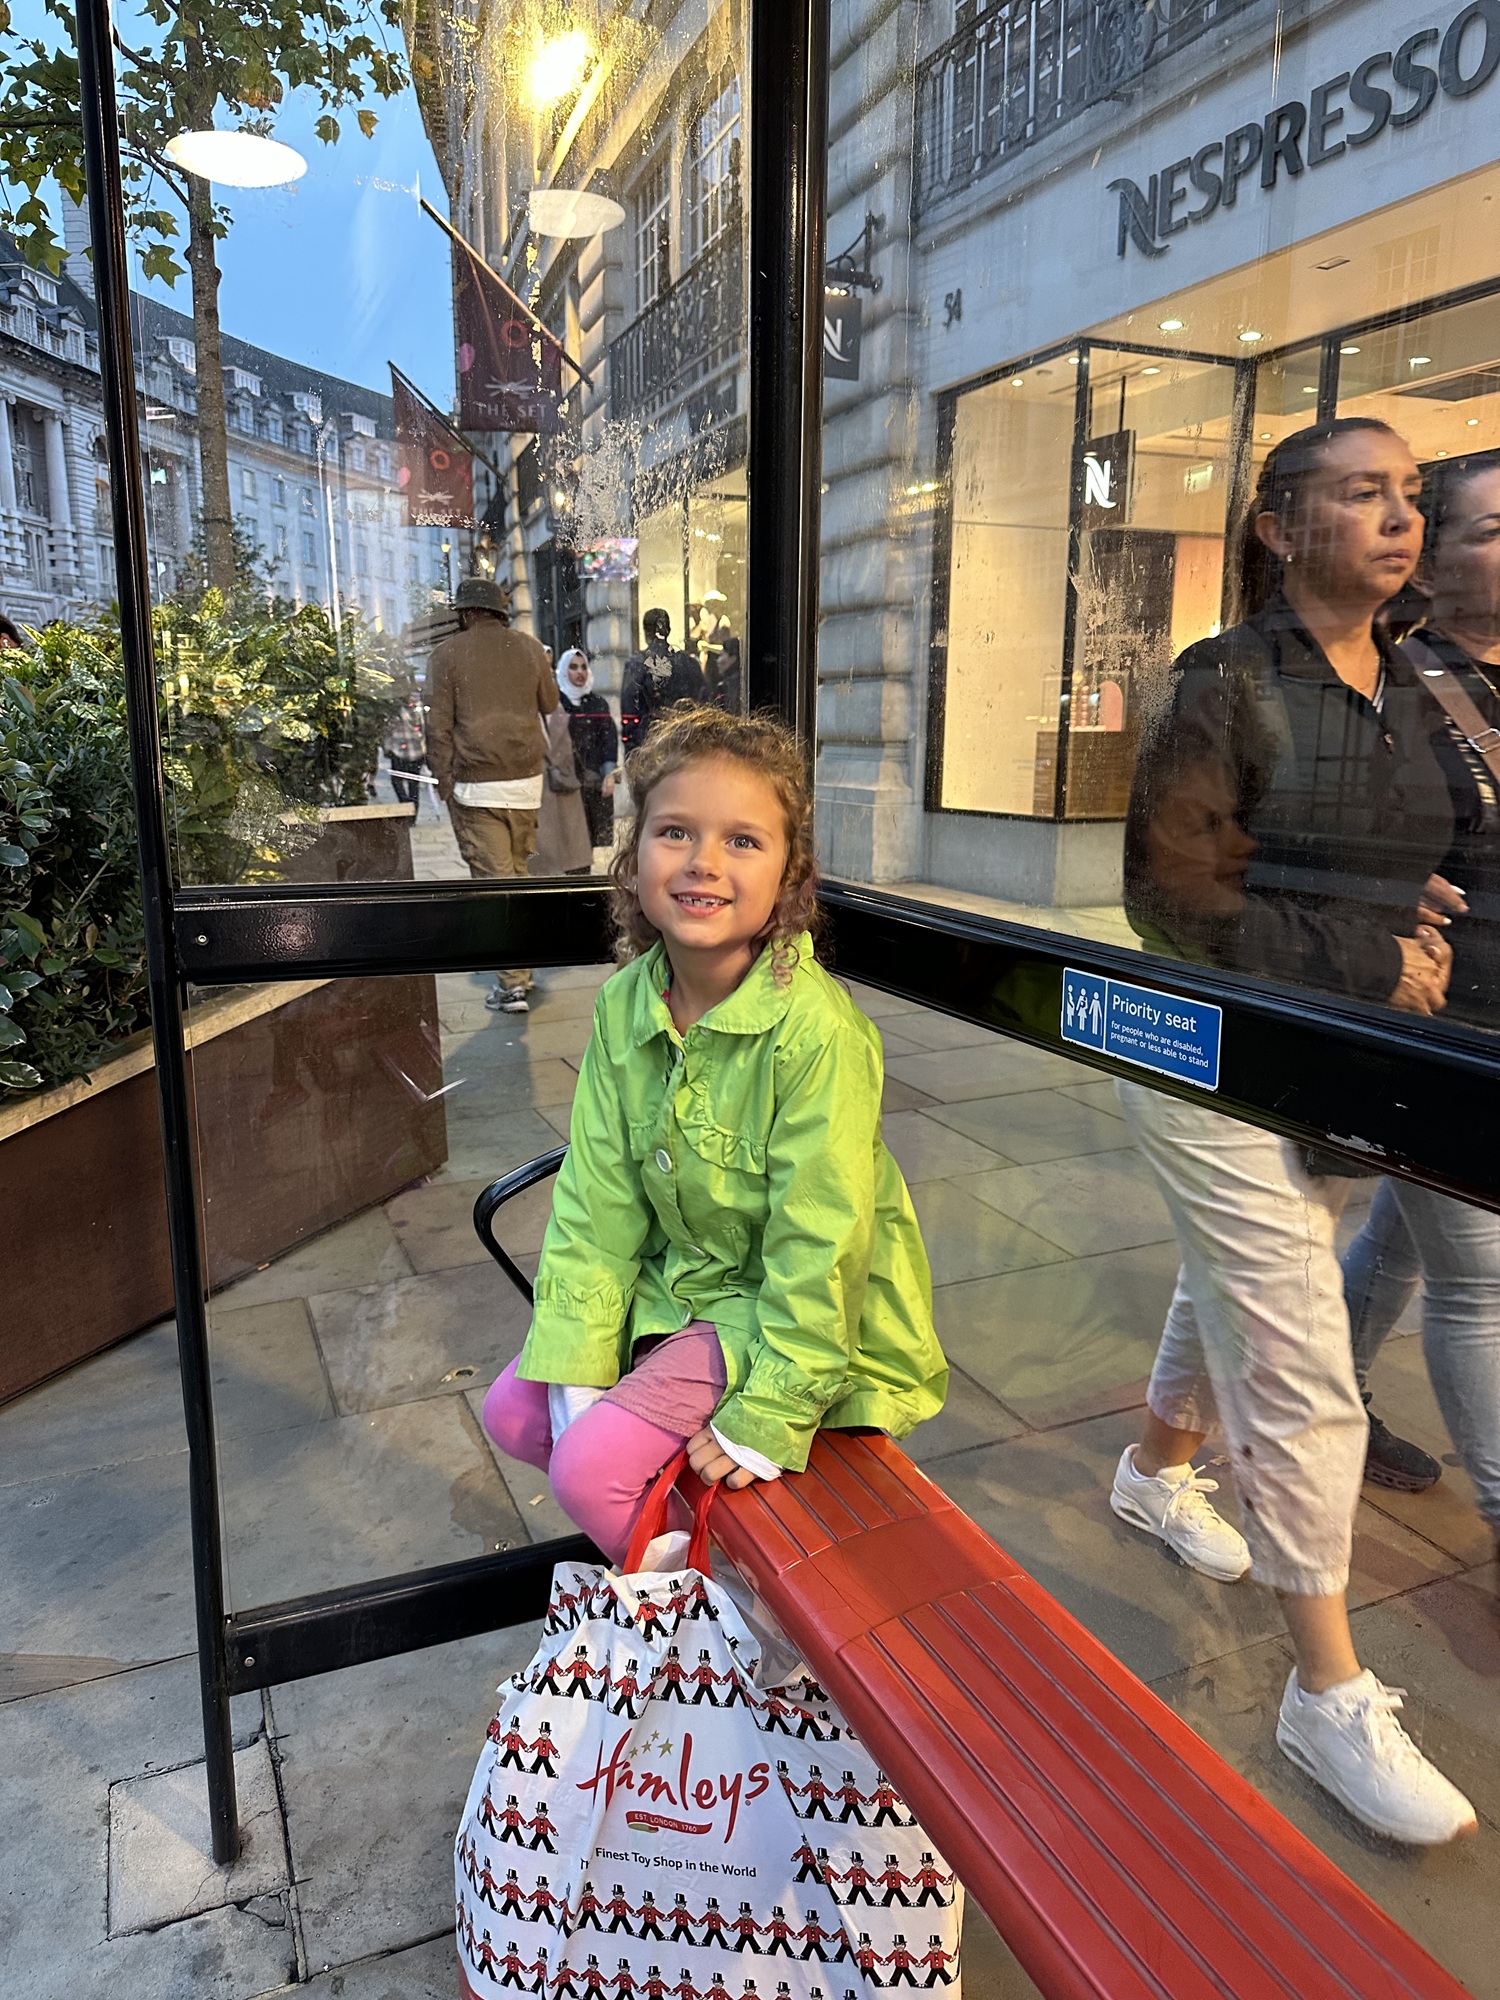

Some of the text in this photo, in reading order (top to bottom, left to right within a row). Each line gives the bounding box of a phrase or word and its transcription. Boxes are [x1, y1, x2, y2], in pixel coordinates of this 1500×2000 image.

[1106, 0, 1500, 258] NESPRESSO
[517, 403, 547, 418] SET
[1083, 457, 1117, 508] N
[1112, 994, 1197, 1033] Priority seat
[1110, 1031, 1209, 1068] pregnant or less able to stand
[1111, 1020, 1204, 1056] for people who are disabled,
[634, 1813, 648, 1821] EST.
[650, 1815, 678, 1829] LONDON
[595, 1847, 757, 1877] Finest Toy Shop in the World
